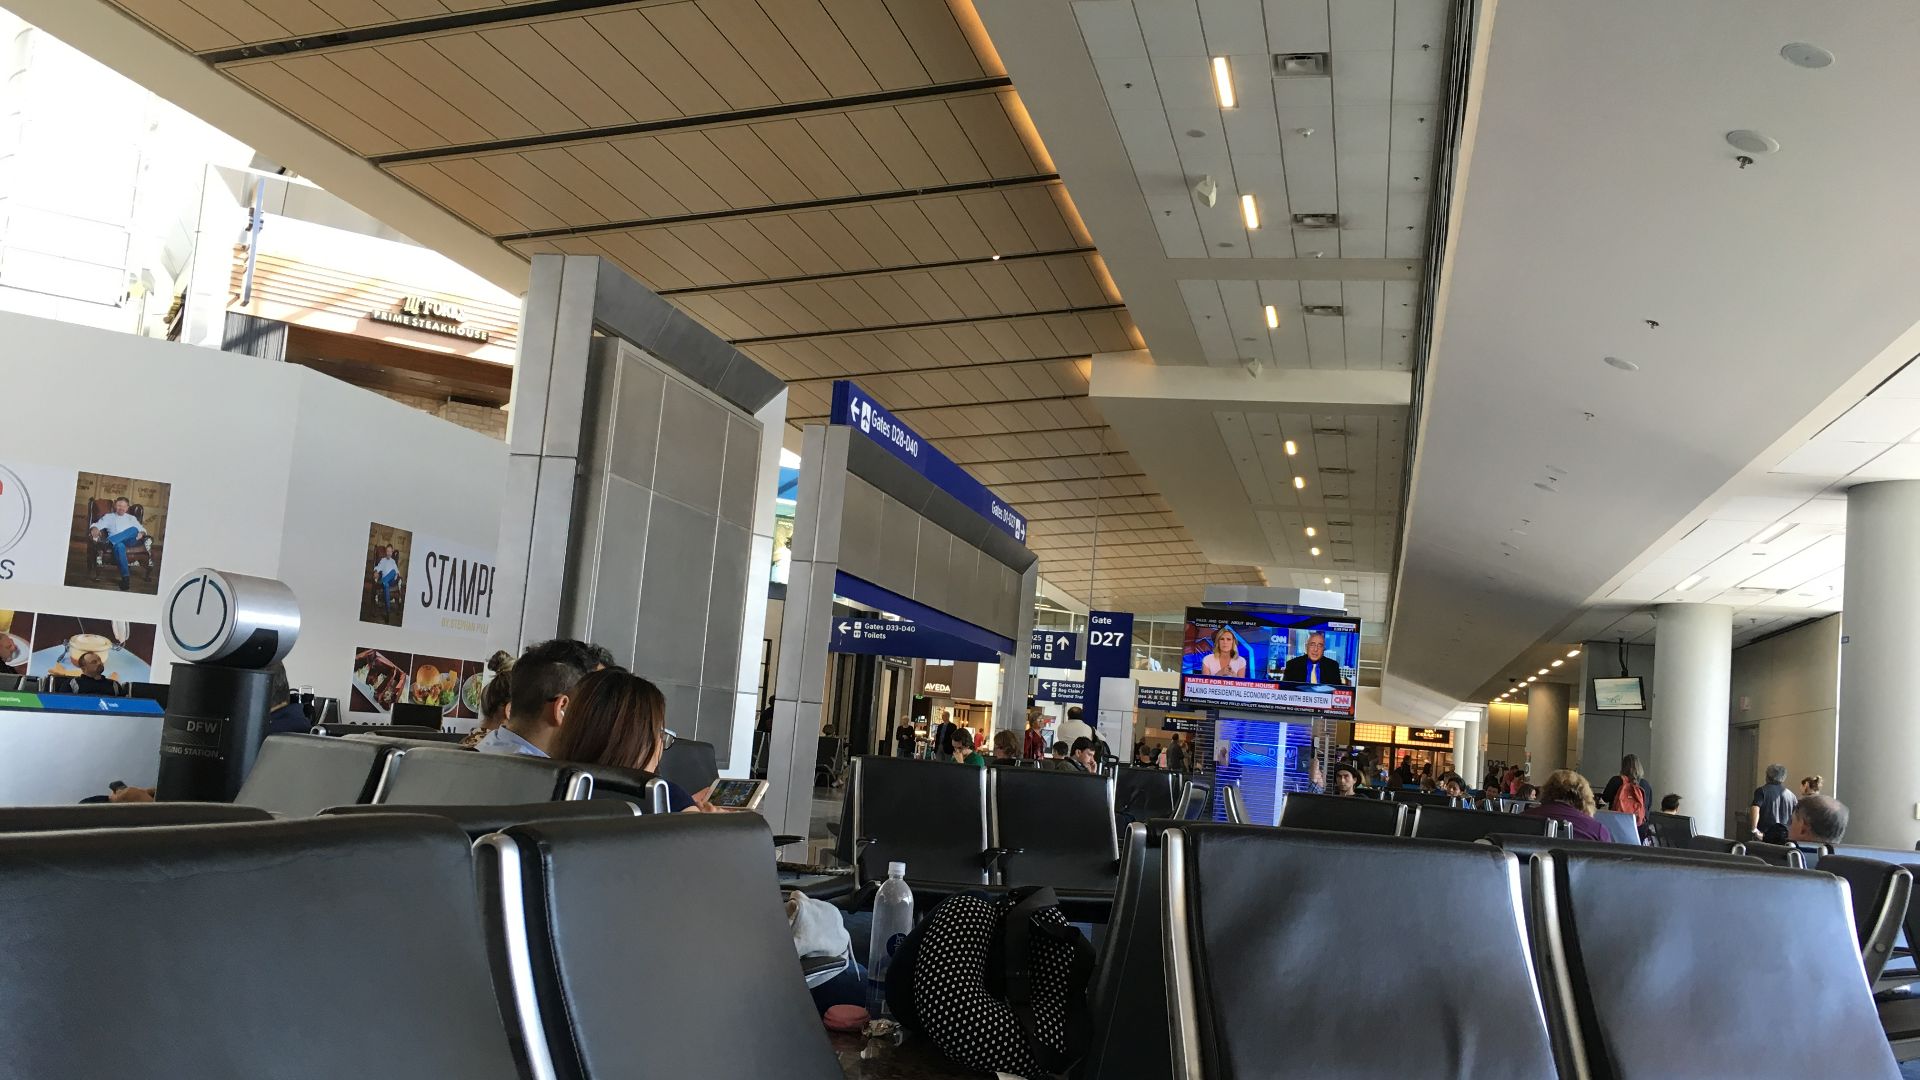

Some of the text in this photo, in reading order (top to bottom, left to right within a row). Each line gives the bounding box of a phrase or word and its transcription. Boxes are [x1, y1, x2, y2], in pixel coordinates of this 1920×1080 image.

[373, 309, 488, 340] PRIME STEAKHOUSE
[872, 409, 919, 458] Gates D28-D40
[991, 500, 1003, 520] Gates
[1091, 616, 1112, 625] Gate
[864, 622, 916, 633] Gates D33-D40
[864, 631, 887, 640] Toilets
[1090, 630, 1125, 647] D27
[1270, 634, 1287, 644] CNN
[924, 682, 951, 692] AVEDA
[1186, 686, 1208, 695] TALKING
[1208, 688, 1242, 697] PRESIDENTIAL
[1243, 690, 1271, 699] ECONOMIC
[1271, 693, 1287, 701] PLANS
[1313, 696, 1329, 704] STEIN
[1333, 696, 1350, 705] CNN
[186, 720, 218, 733] DFW
[184, 747, 219, 758] STATION
